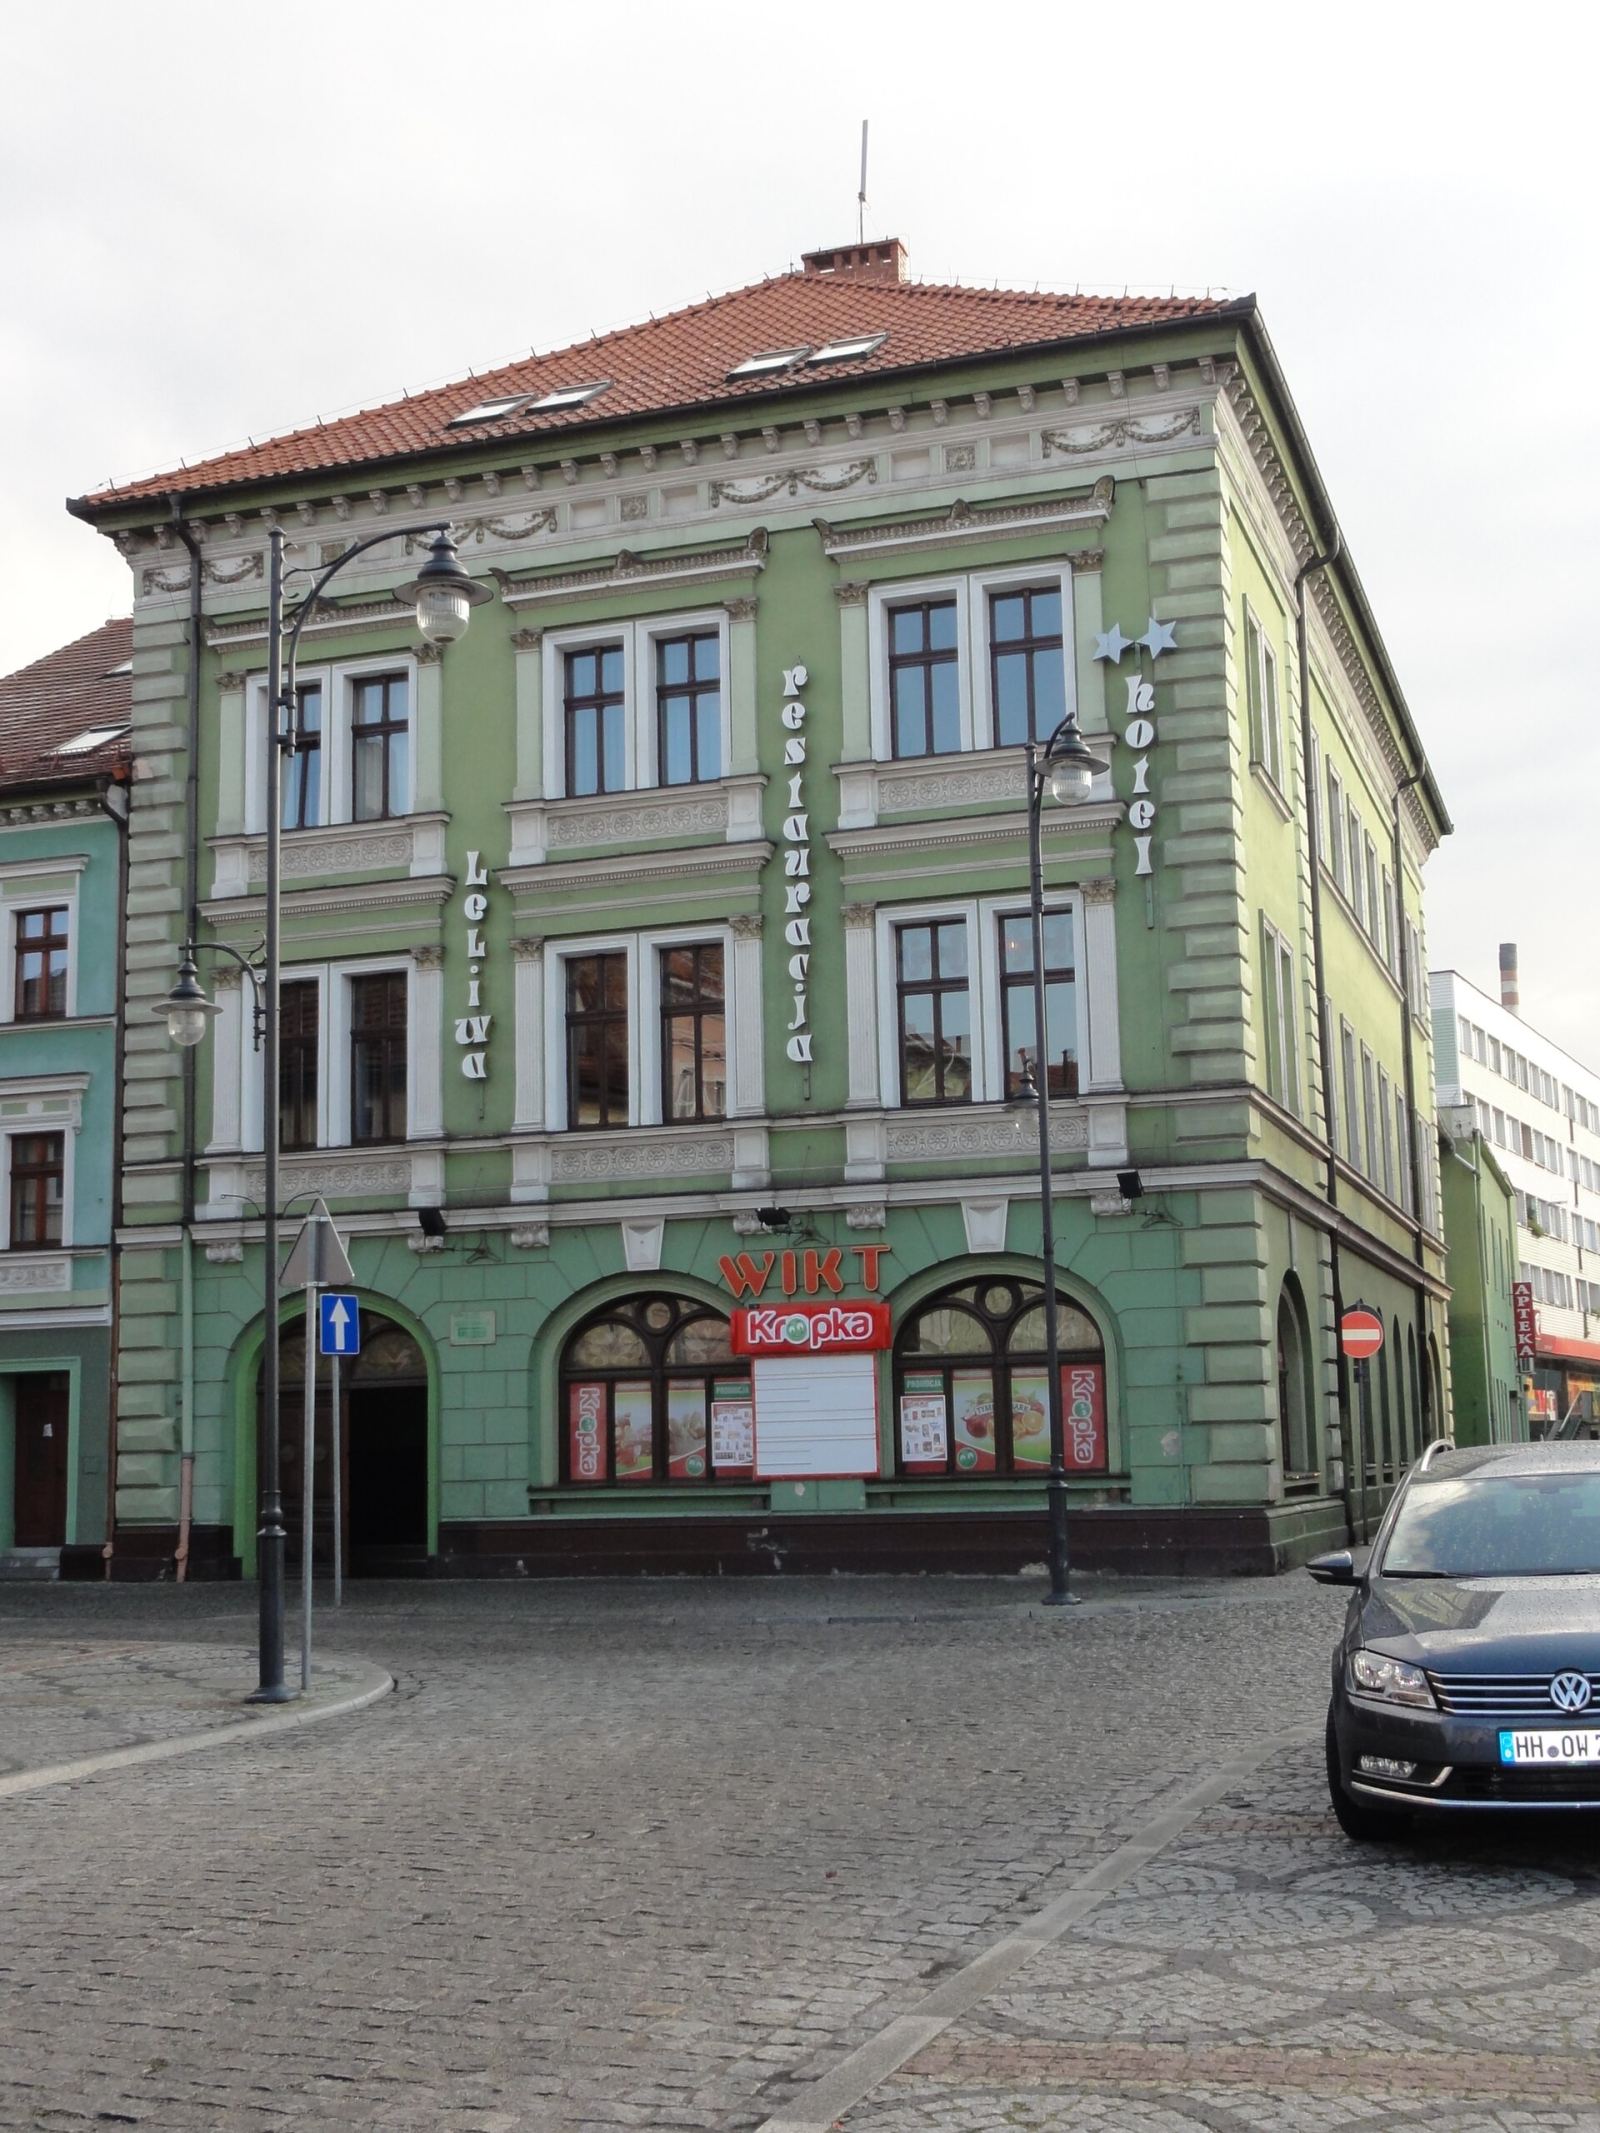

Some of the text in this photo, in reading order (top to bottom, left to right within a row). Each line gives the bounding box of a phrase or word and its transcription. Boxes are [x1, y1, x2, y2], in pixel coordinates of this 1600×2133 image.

[1125, 674, 1155, 876] hotel
[782, 664, 813, 1062] restauracja
[747, 1307, 874, 1350] Kropka
[1514, 1284, 1535, 1356] APTEKA
[575, 1387, 601, 1475] Kropka
[1068, 1370, 1097, 1463] Kropka
[1515, 1735, 1544, 1758] HH
